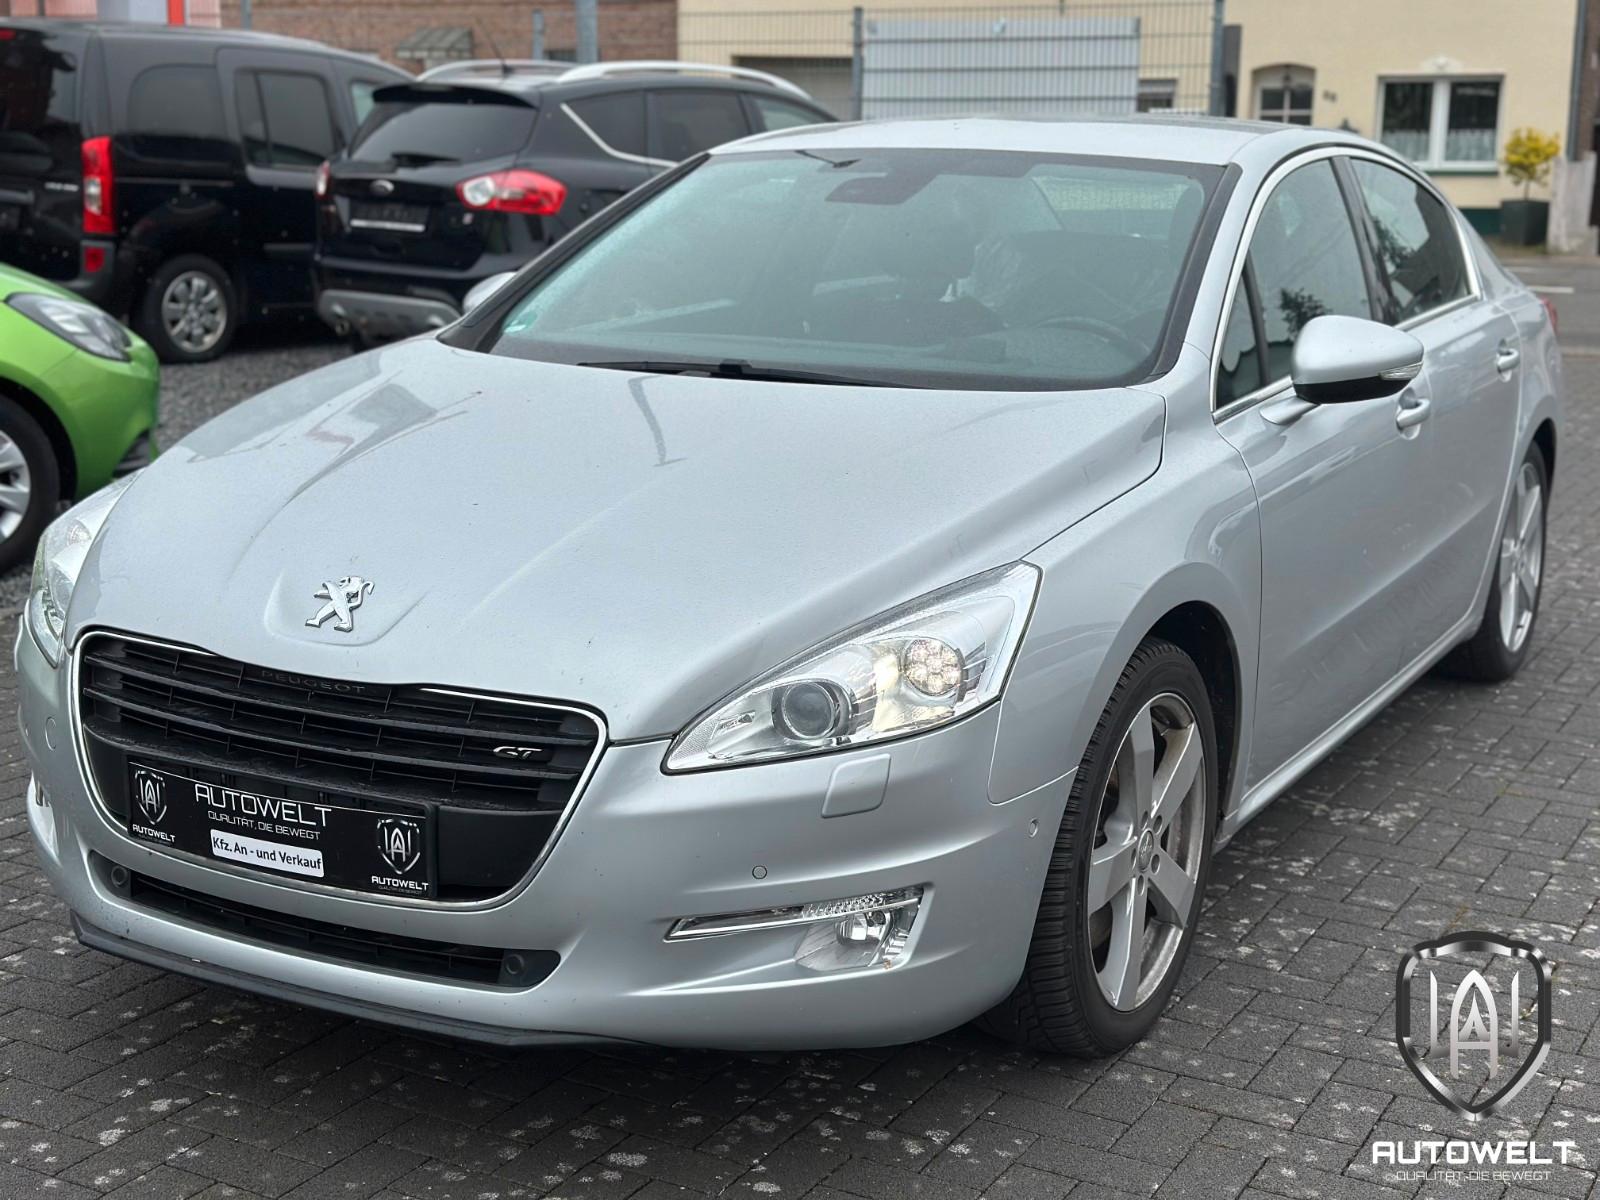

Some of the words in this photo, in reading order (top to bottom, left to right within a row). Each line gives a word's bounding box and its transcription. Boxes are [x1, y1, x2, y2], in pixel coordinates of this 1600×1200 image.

[262, 669, 365, 693] PEUGEOT
[493, 746, 543, 759] GT
[194, 783, 333, 827] AUTOWELT
[132, 823, 176, 843] AUTOWELT
[258, 821, 274, 833] DIE
[275, 824, 321, 841] BEWEGT
[212, 836, 233, 852] Kfz.
[233, 842, 248, 856] An
[256, 848, 277, 862] und
[278, 850, 322, 870] Verkauf
[371, 875, 429, 891] AUTOWELT
